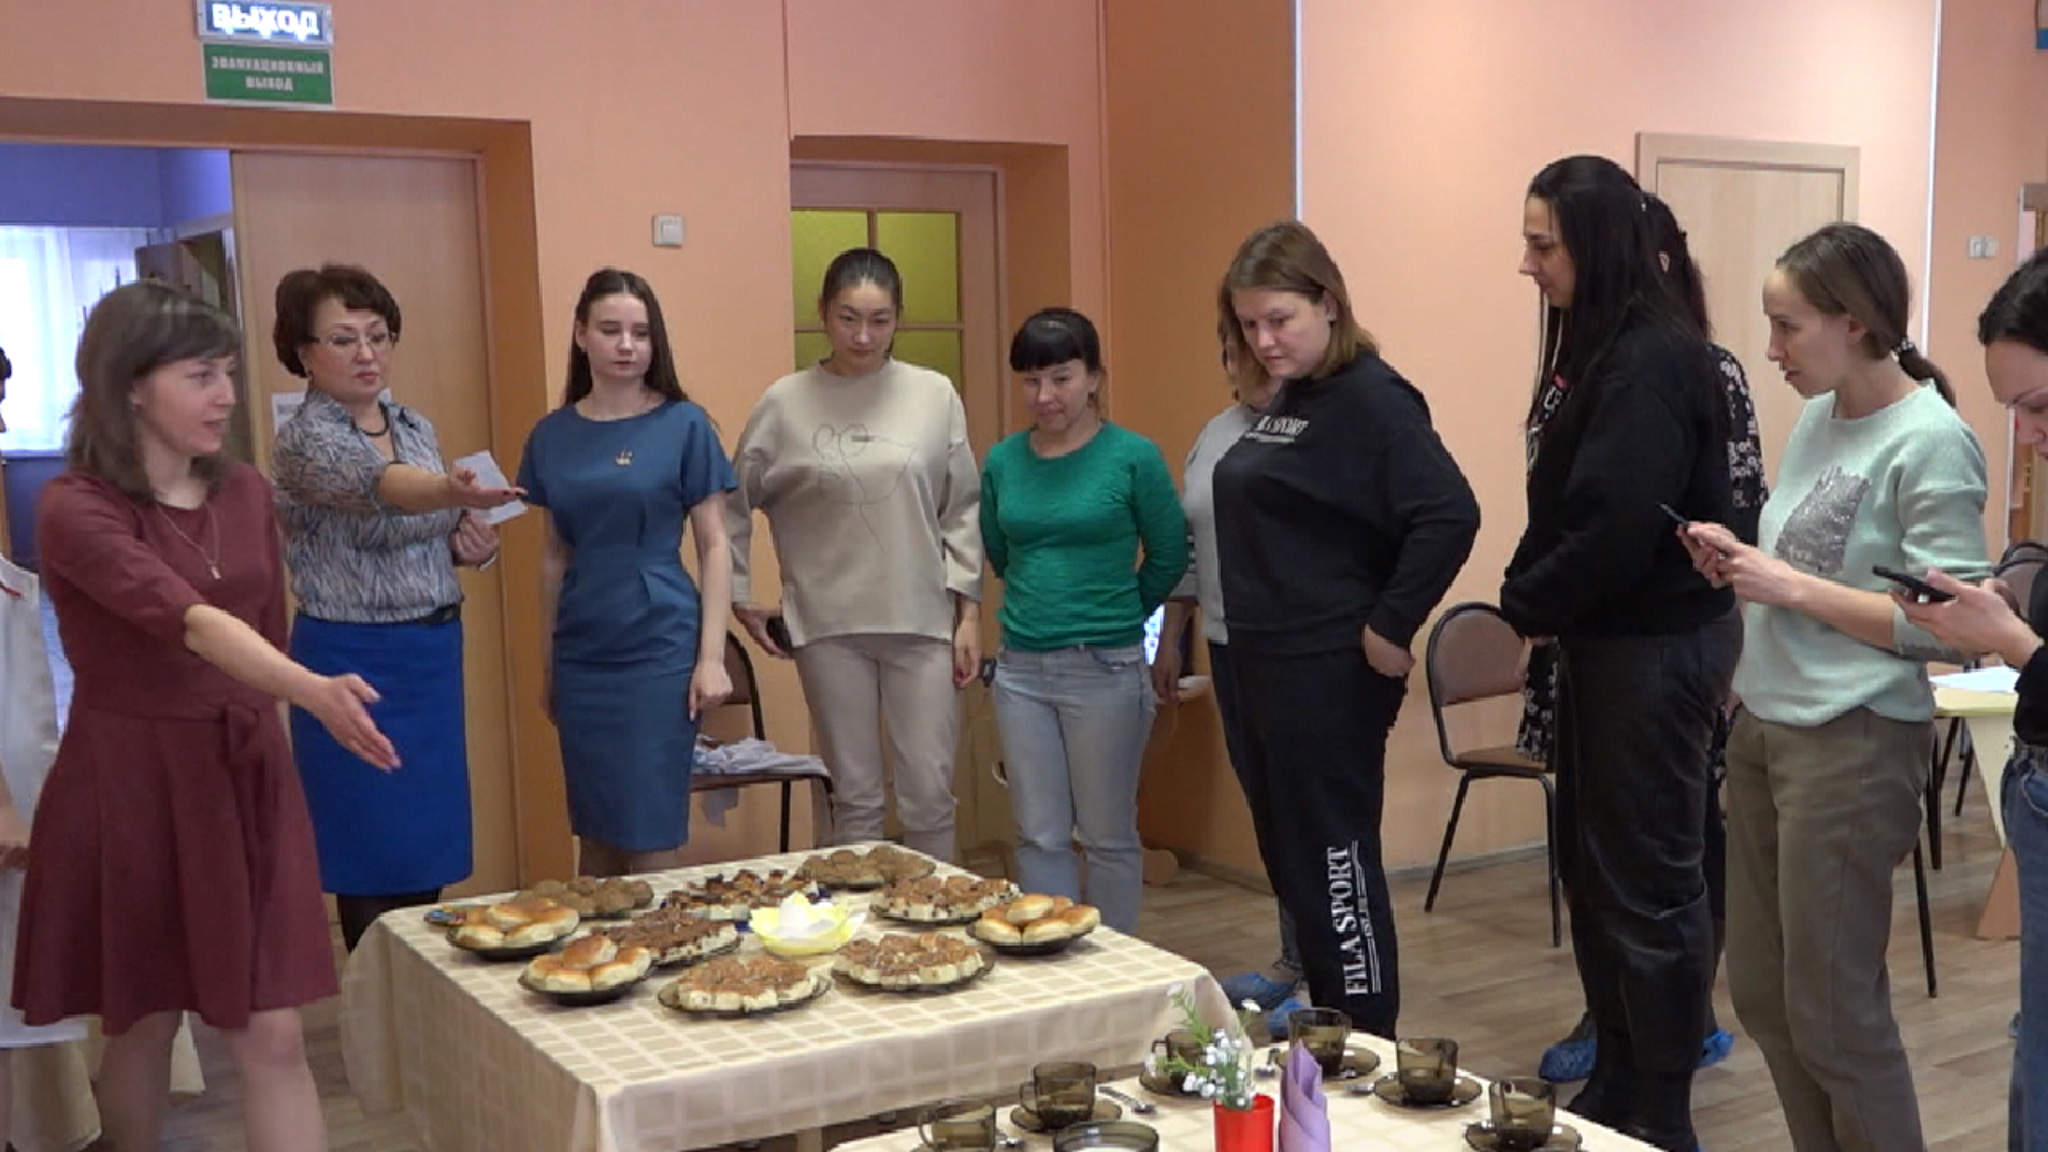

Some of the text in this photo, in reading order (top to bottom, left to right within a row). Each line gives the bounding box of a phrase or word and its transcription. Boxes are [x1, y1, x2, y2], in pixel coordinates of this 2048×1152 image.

[211, 3, 320, 37] ВЫХОД
[245, 76, 294, 92] ВЫХОД
[1327, 847, 1357, 933] SPORT
